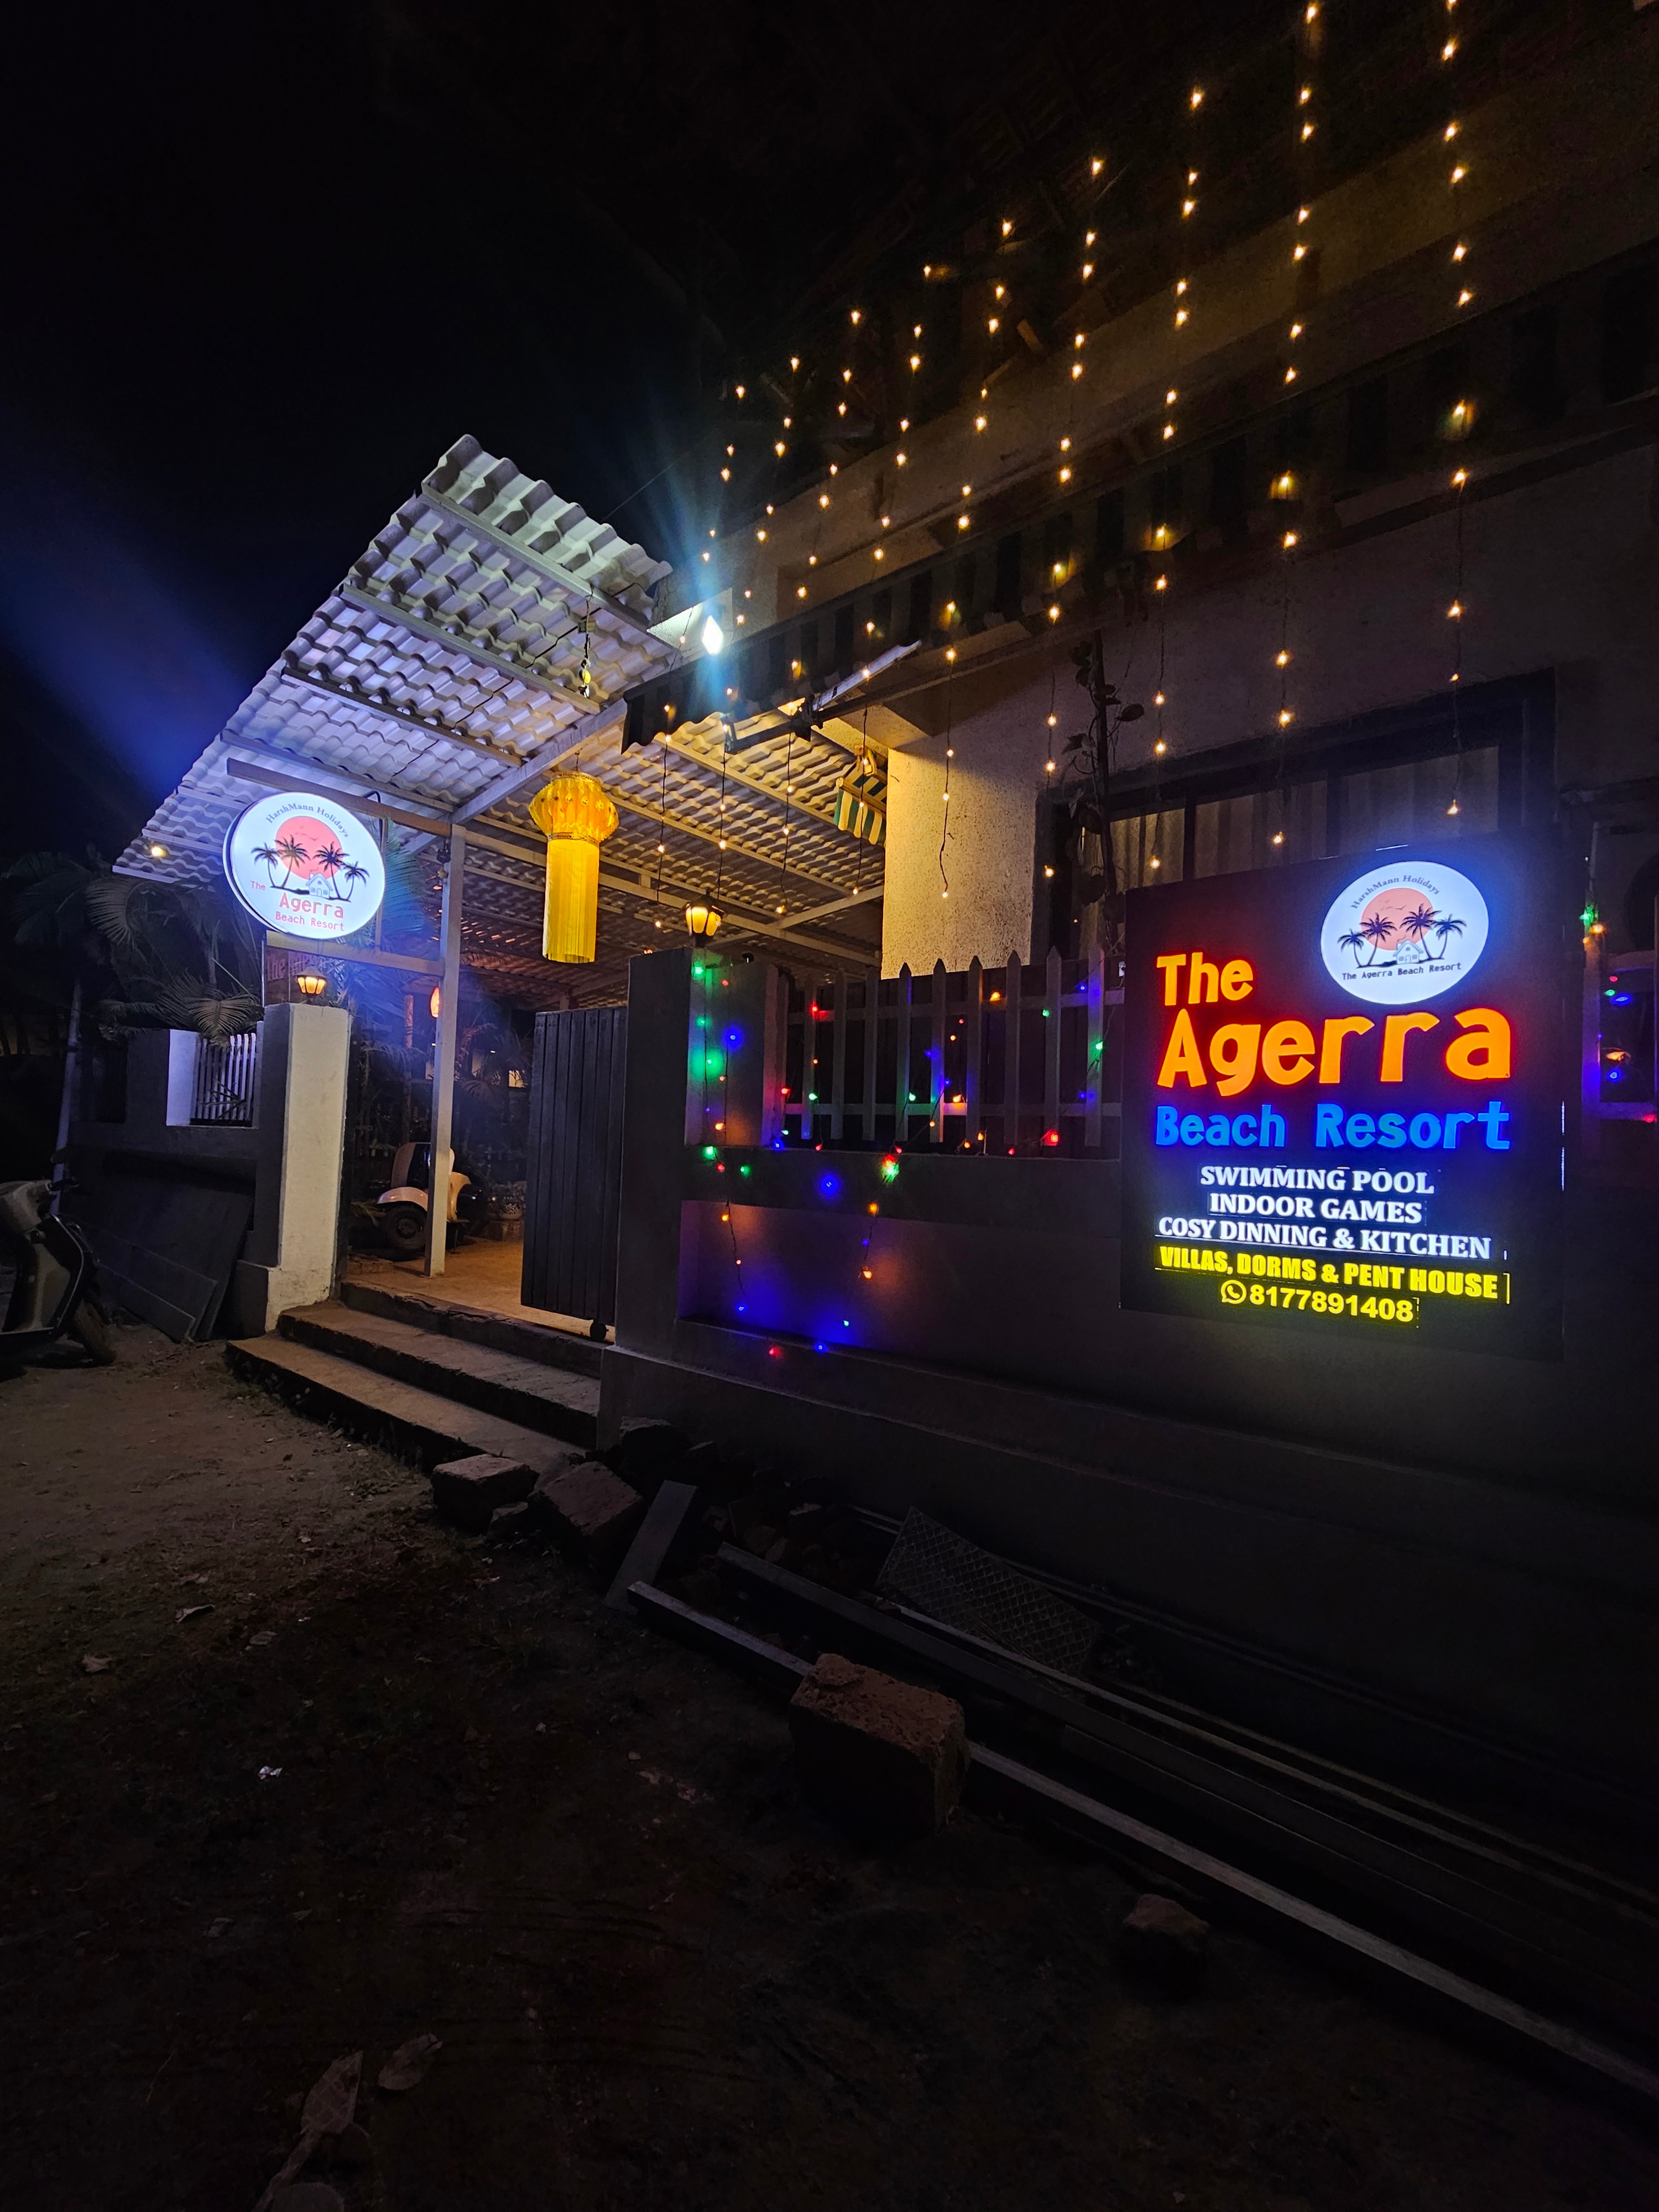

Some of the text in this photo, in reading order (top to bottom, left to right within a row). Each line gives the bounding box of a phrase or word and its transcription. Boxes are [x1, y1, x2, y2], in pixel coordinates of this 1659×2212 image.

[317, 807, 349, 838] Holidays
[251, 881, 266, 891] The
[1402, 875, 1440, 895] Holidays
[275, 911, 345, 931] Beach Resort
[279, 892, 344, 919] Agerra
[1156, 952, 1254, 1006] The
[1361, 970, 1393, 979] Agerra
[1397, 966, 1424, 975] Beach
[1429, 962, 1462, 973] Resort
[1156, 1008, 1511, 1097] Agerra
[1155, 1100, 1511, 1150] Beach Resort
[1200, 1165, 1435, 1194] SWIMMING POOL
[1209, 1192, 1422, 1224] INDOOR GAMES
[1159, 1217, 1493, 1260] COSY DINNING & KITCHEN
[1160, 1245, 1499, 1300] VILLAS, DORMS & PENT HOUSE
[1249, 1284, 1414, 1322] 8177891408
